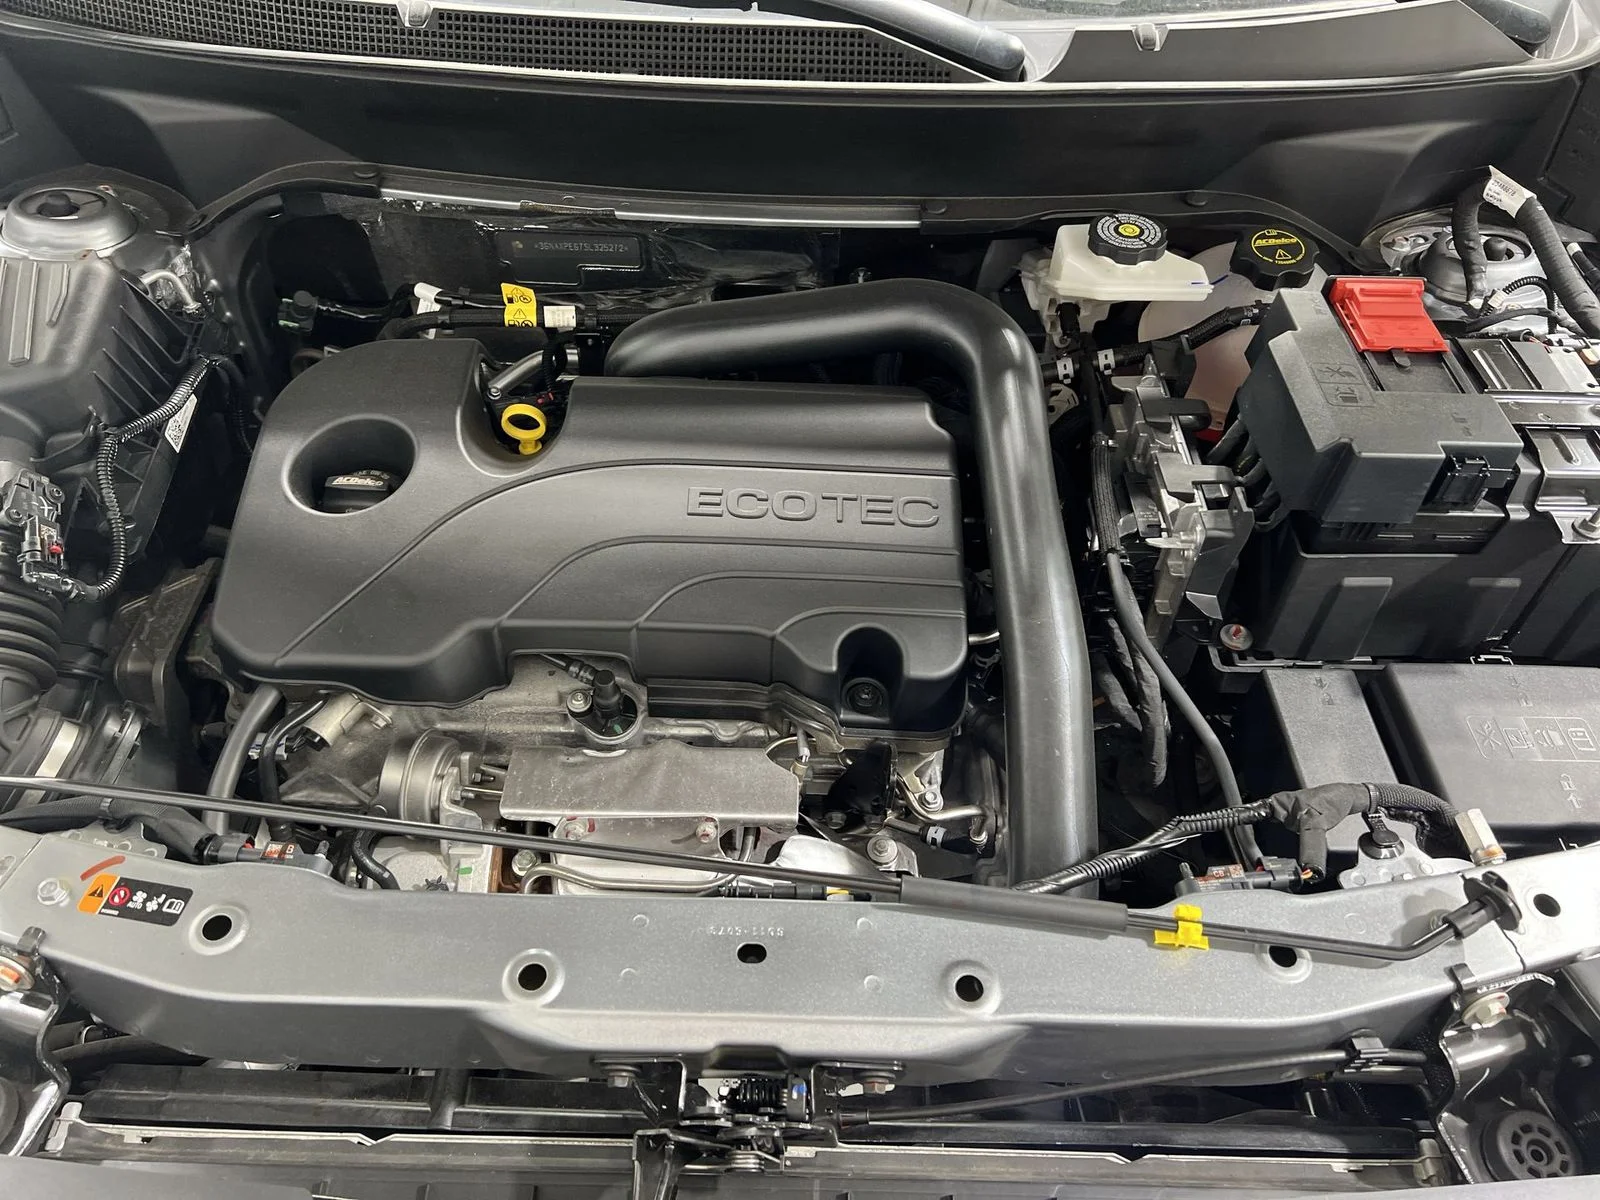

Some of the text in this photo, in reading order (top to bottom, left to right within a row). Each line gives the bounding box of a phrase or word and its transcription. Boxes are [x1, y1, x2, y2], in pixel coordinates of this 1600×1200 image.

[1254, 237, 1297, 246] ACDelco
[331, 476, 384, 486] ACDelco
[687, 486, 940, 528] ECOTEC
[127, 900, 143, 910] AUTO
